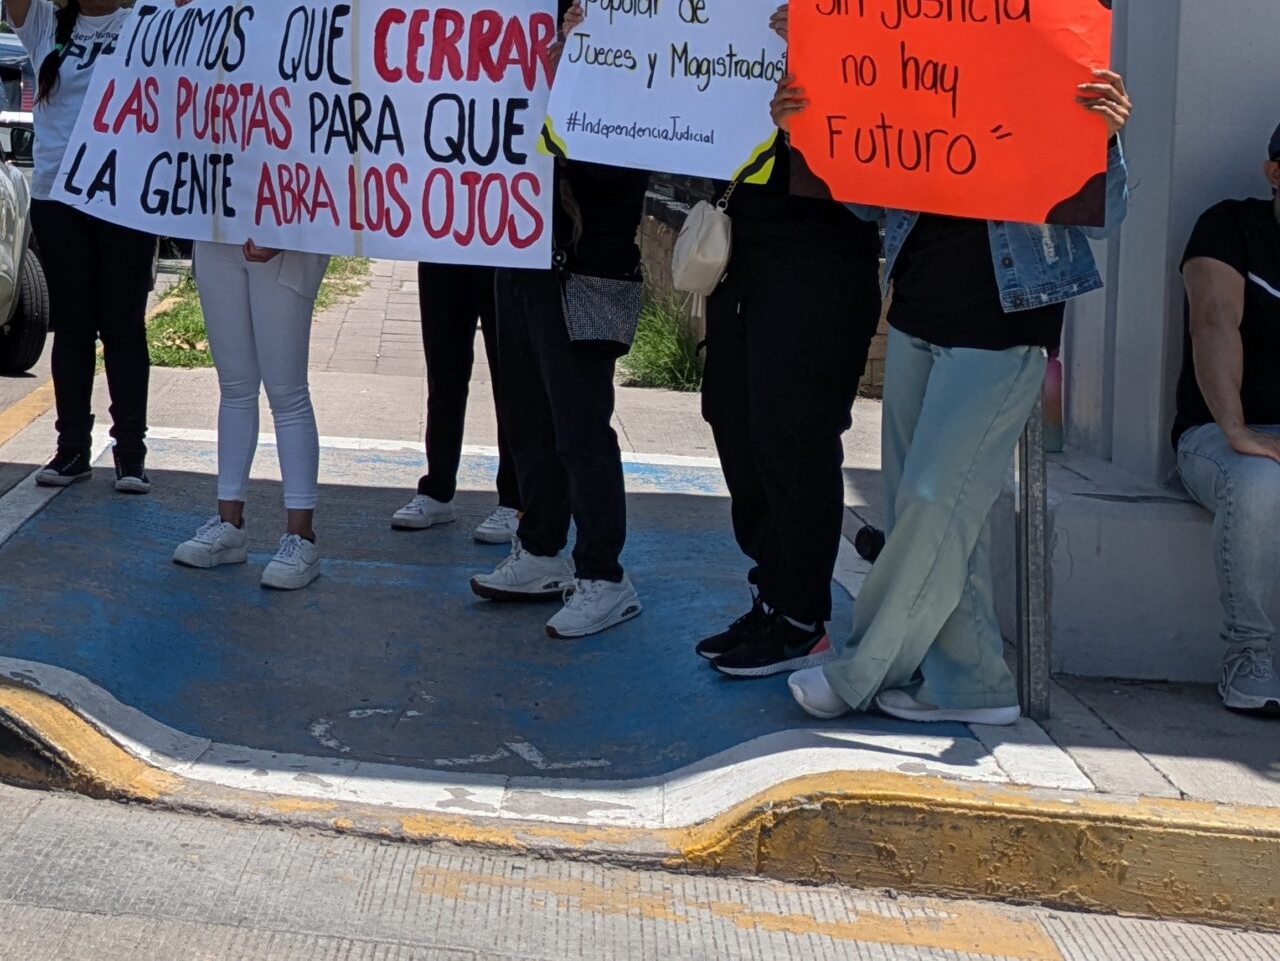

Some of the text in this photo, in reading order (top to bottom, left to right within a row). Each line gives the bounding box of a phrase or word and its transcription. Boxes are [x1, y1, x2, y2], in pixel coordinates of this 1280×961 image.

[125, 3, 556, 91] TUVIMOS QUE CERRAR
[568, 32, 637, 70] Jueces
[647, 52, 658, 89] y
[841, 41, 959, 118] no hay
[92, 76, 531, 166] LAS PUERTAS PARA QUE
[566, 111, 715, 145] #IndependenciaJudicial
[63, 141, 545, 250] LA GENTE ABRA LOS OJOS
